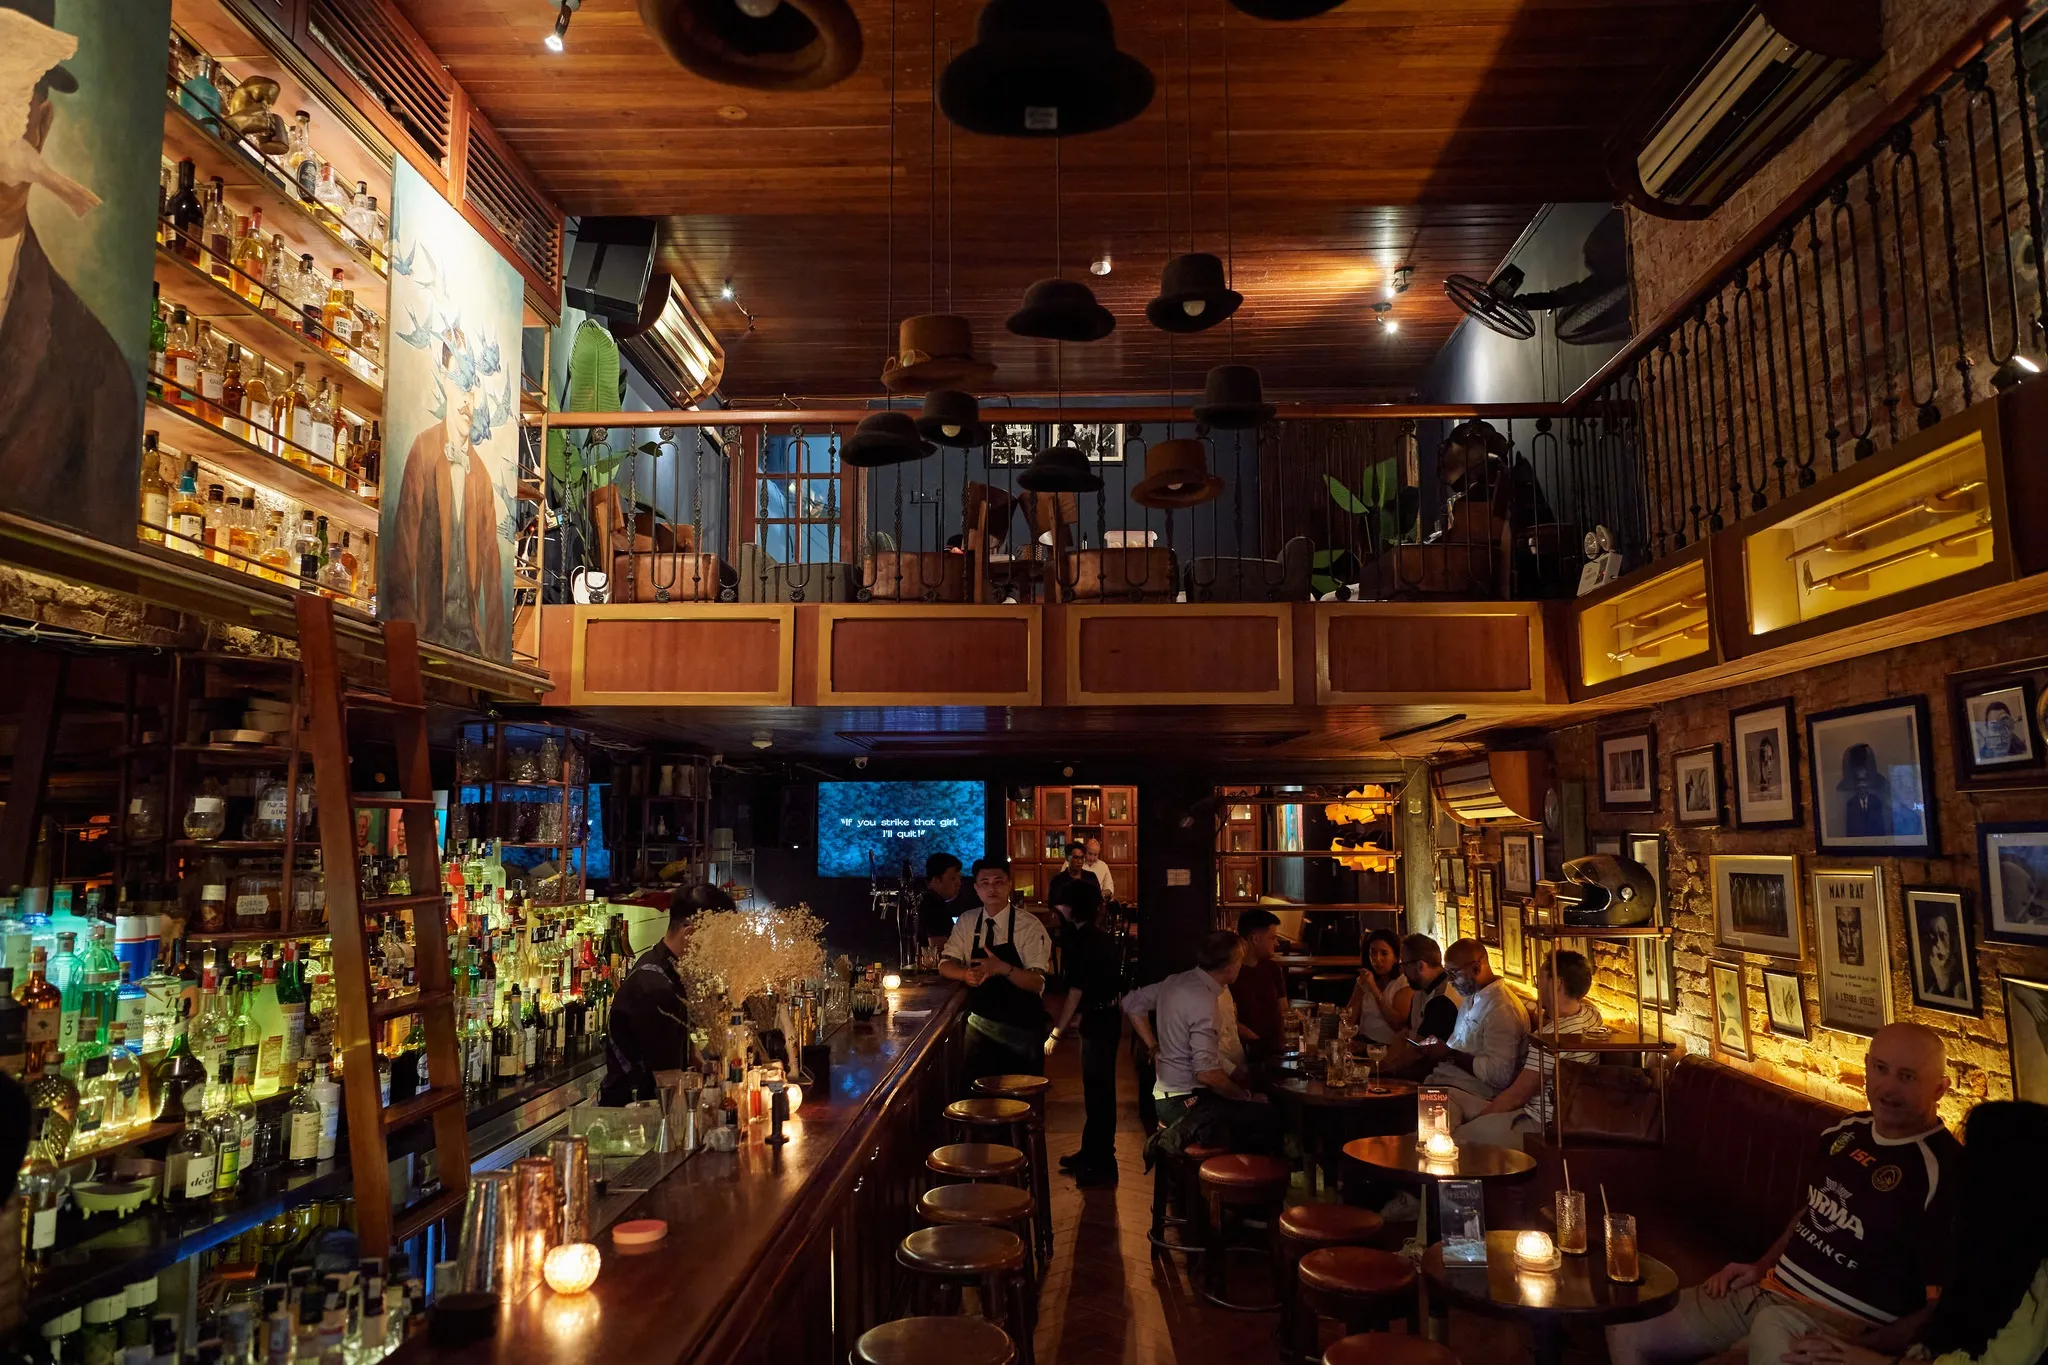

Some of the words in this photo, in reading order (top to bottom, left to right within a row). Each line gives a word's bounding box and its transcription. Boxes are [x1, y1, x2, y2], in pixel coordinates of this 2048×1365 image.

[857, 819, 876, 828] you
[881, 818, 910, 826] strike
[914, 818, 936, 826] that
[939, 818, 959, 828] girl,
[882, 829, 893, 838] I'll
[1828, 883, 1845, 899] MAN
[1849, 883, 1864, 900] RAY
[65, 1020, 73, 1036] 3
[1419, 1093, 1448, 1101] WHISKY
[1848, 1148, 1877, 1167] ISC
[1806, 1183, 1864, 1241] NRMA
